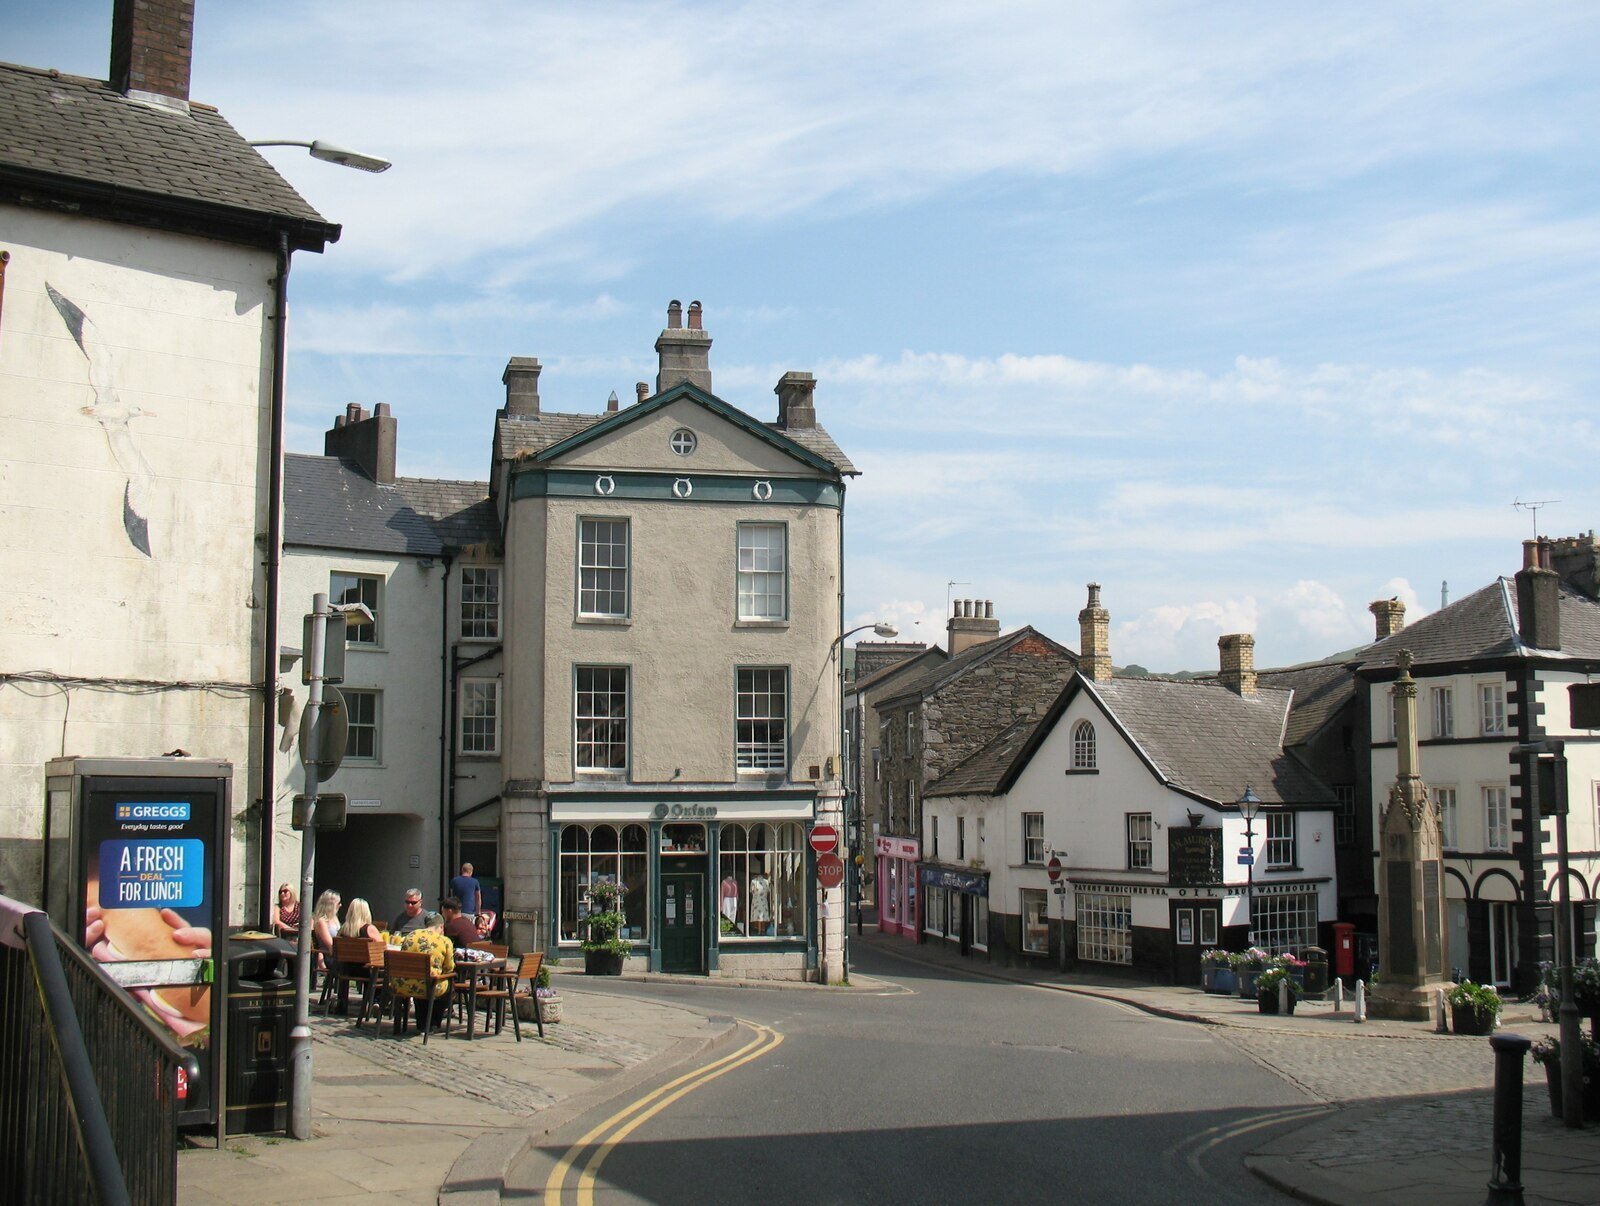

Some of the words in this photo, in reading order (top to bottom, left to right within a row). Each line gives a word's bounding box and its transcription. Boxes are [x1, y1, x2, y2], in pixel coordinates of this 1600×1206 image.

[133, 806, 187, 817] GREGGS
[671, 803, 718, 816] Oxfam
[168, 823, 184, 831] good
[120, 846, 131, 871] A
[136, 846, 184, 871] FRESH
[817, 865, 843, 875] STOP
[140, 873, 164, 881] DEAL
[120, 882, 141, 901] FOR
[145, 881, 183, 900] LUNCH
[1074, 884, 1102, 892] PATENT
[1104, 886, 1148, 894] MEDICINES
[1258, 884, 1318, 894] WAREHOUSE
